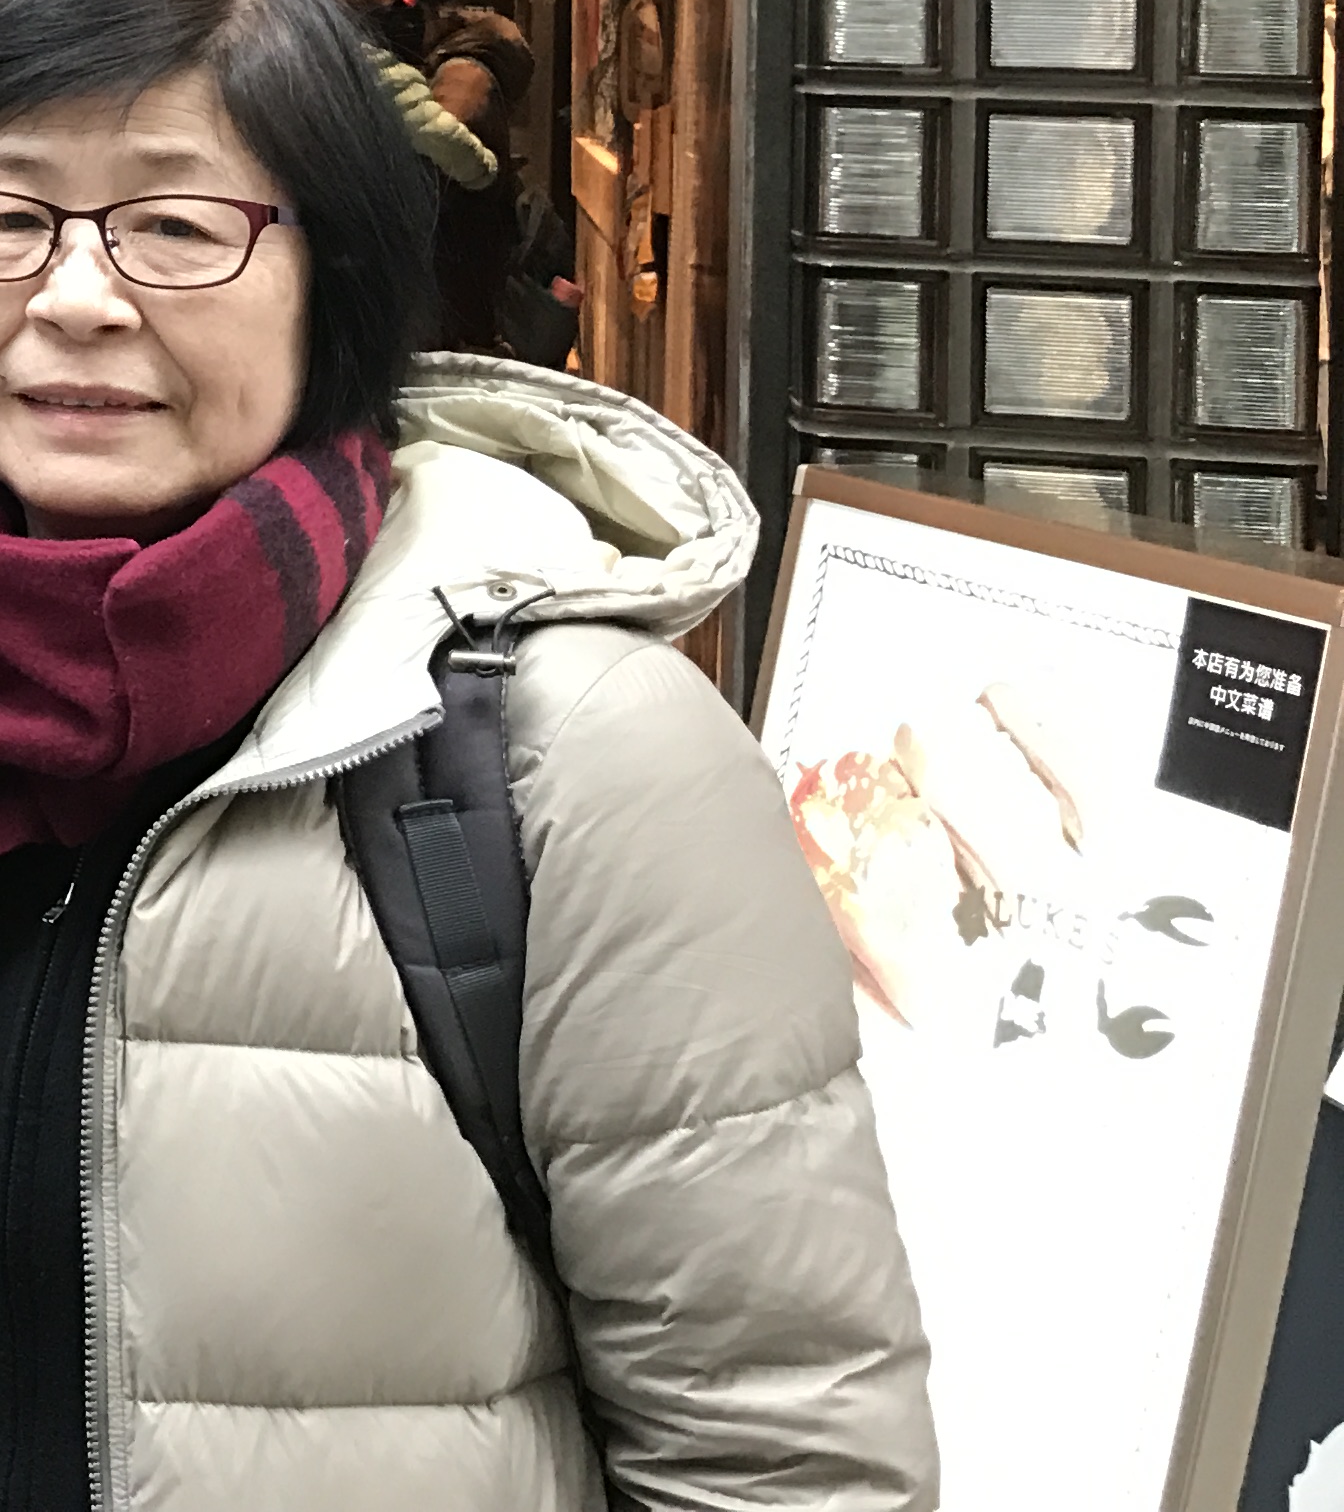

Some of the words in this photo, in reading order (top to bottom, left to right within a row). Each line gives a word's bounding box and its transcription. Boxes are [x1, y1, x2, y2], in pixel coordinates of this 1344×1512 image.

[1192, 648, 1303, 697] 本店有为您准备
[1209, 685, 1275, 721] 中文菜谱
